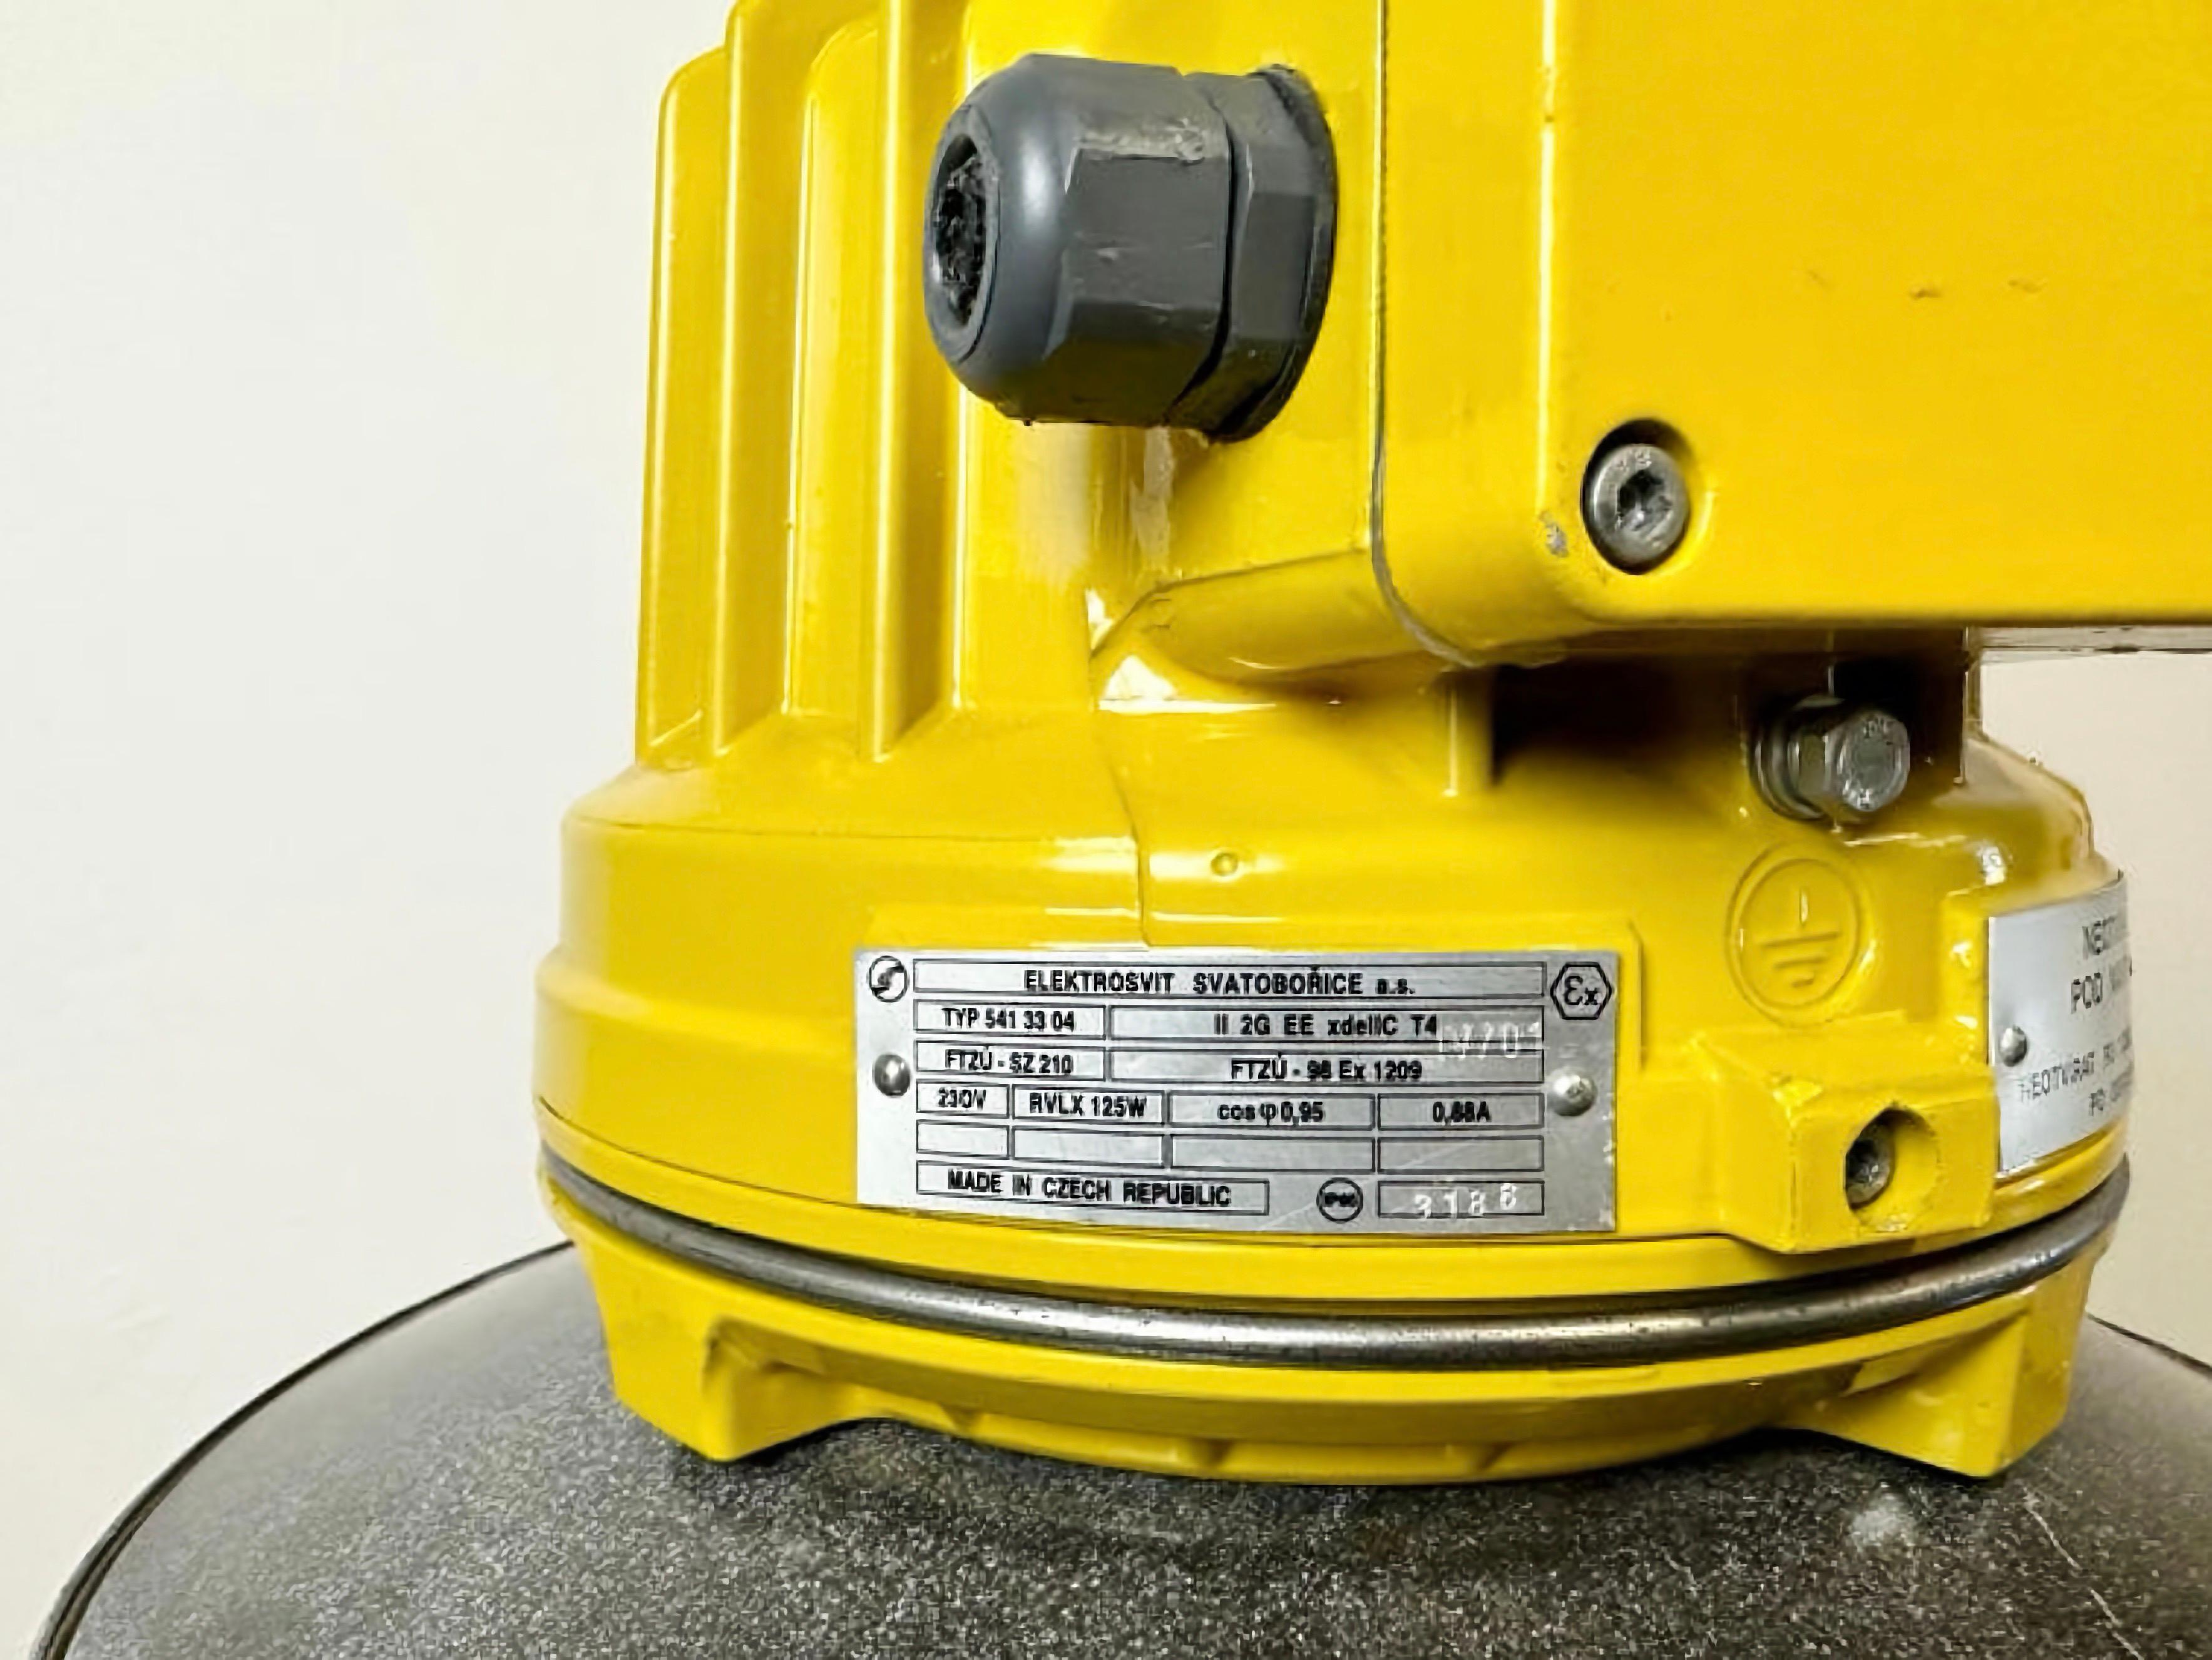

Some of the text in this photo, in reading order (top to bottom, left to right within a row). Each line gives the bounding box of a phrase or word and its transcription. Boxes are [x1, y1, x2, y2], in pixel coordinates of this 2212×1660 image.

[1023, 965, 1416, 995] ELEKTROSVIT SVATOBOŘICE a.s.
[941, 1007, 1076, 1033] TYP 541 33 04
[1239, 1013, 1271, 1037] 2G
[1283, 1013, 1314, 1036] EE
[1410, 1013, 1438, 1037] T4
[1008, 1052, 1037, 1075] SZ
[1039, 1053, 1075, 1075] 210
[1338, 1059, 1366, 1082] Ex
[1373, 1059, 1423, 1082] 1209
[937, 1087, 988, 1111] 230V
[1028, 1090, 1148, 1119] RVLX 125W
[947, 1167, 1233, 1207] MADE IN CZECH REPUBLIC
